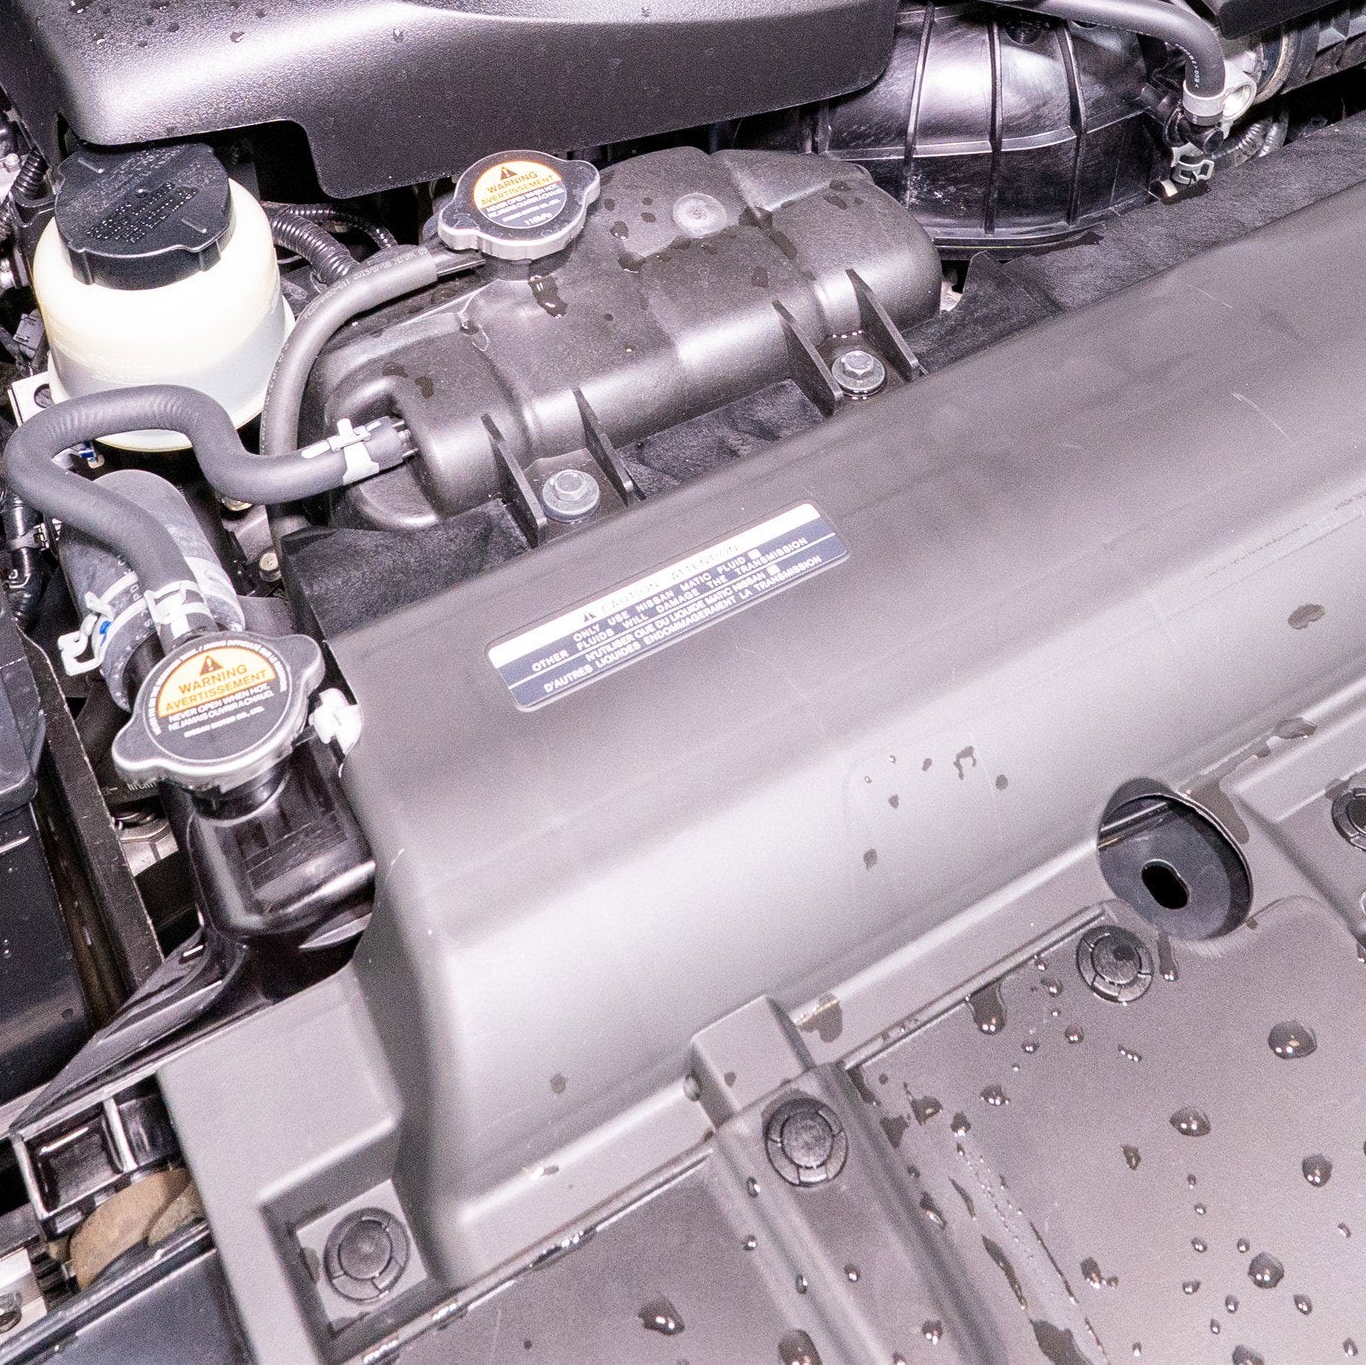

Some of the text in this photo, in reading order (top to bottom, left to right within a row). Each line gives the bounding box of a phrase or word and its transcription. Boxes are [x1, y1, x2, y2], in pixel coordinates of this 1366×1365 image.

[487, 172, 537, 193] WARNING
[530, 536, 809, 673] OTHER FLUIDS WILL DAMAGE THE TRANSMISSION
[571, 555, 746, 642] ONLY USE NISSAN MATIC FLUID
[654, 615, 672, 629] DU
[668, 598, 706, 621] LIQUIDE
[702, 586, 734, 606] MATIC
[731, 571, 765, 592] NISSAN
[542, 663, 593, 694] D'AUTRES
[594, 640, 641, 668] LIQUIDES
[737, 586, 753, 599] LA
[752, 554, 823, 592] TRANSMISSION
[166, 670, 267, 711] AVERTISSEMENT
[179, 664, 248, 694] WARNING
[169, 708, 197, 722] NEVER
[198, 701, 223, 713] OPEN
[223, 692, 249, 706] WHEN
